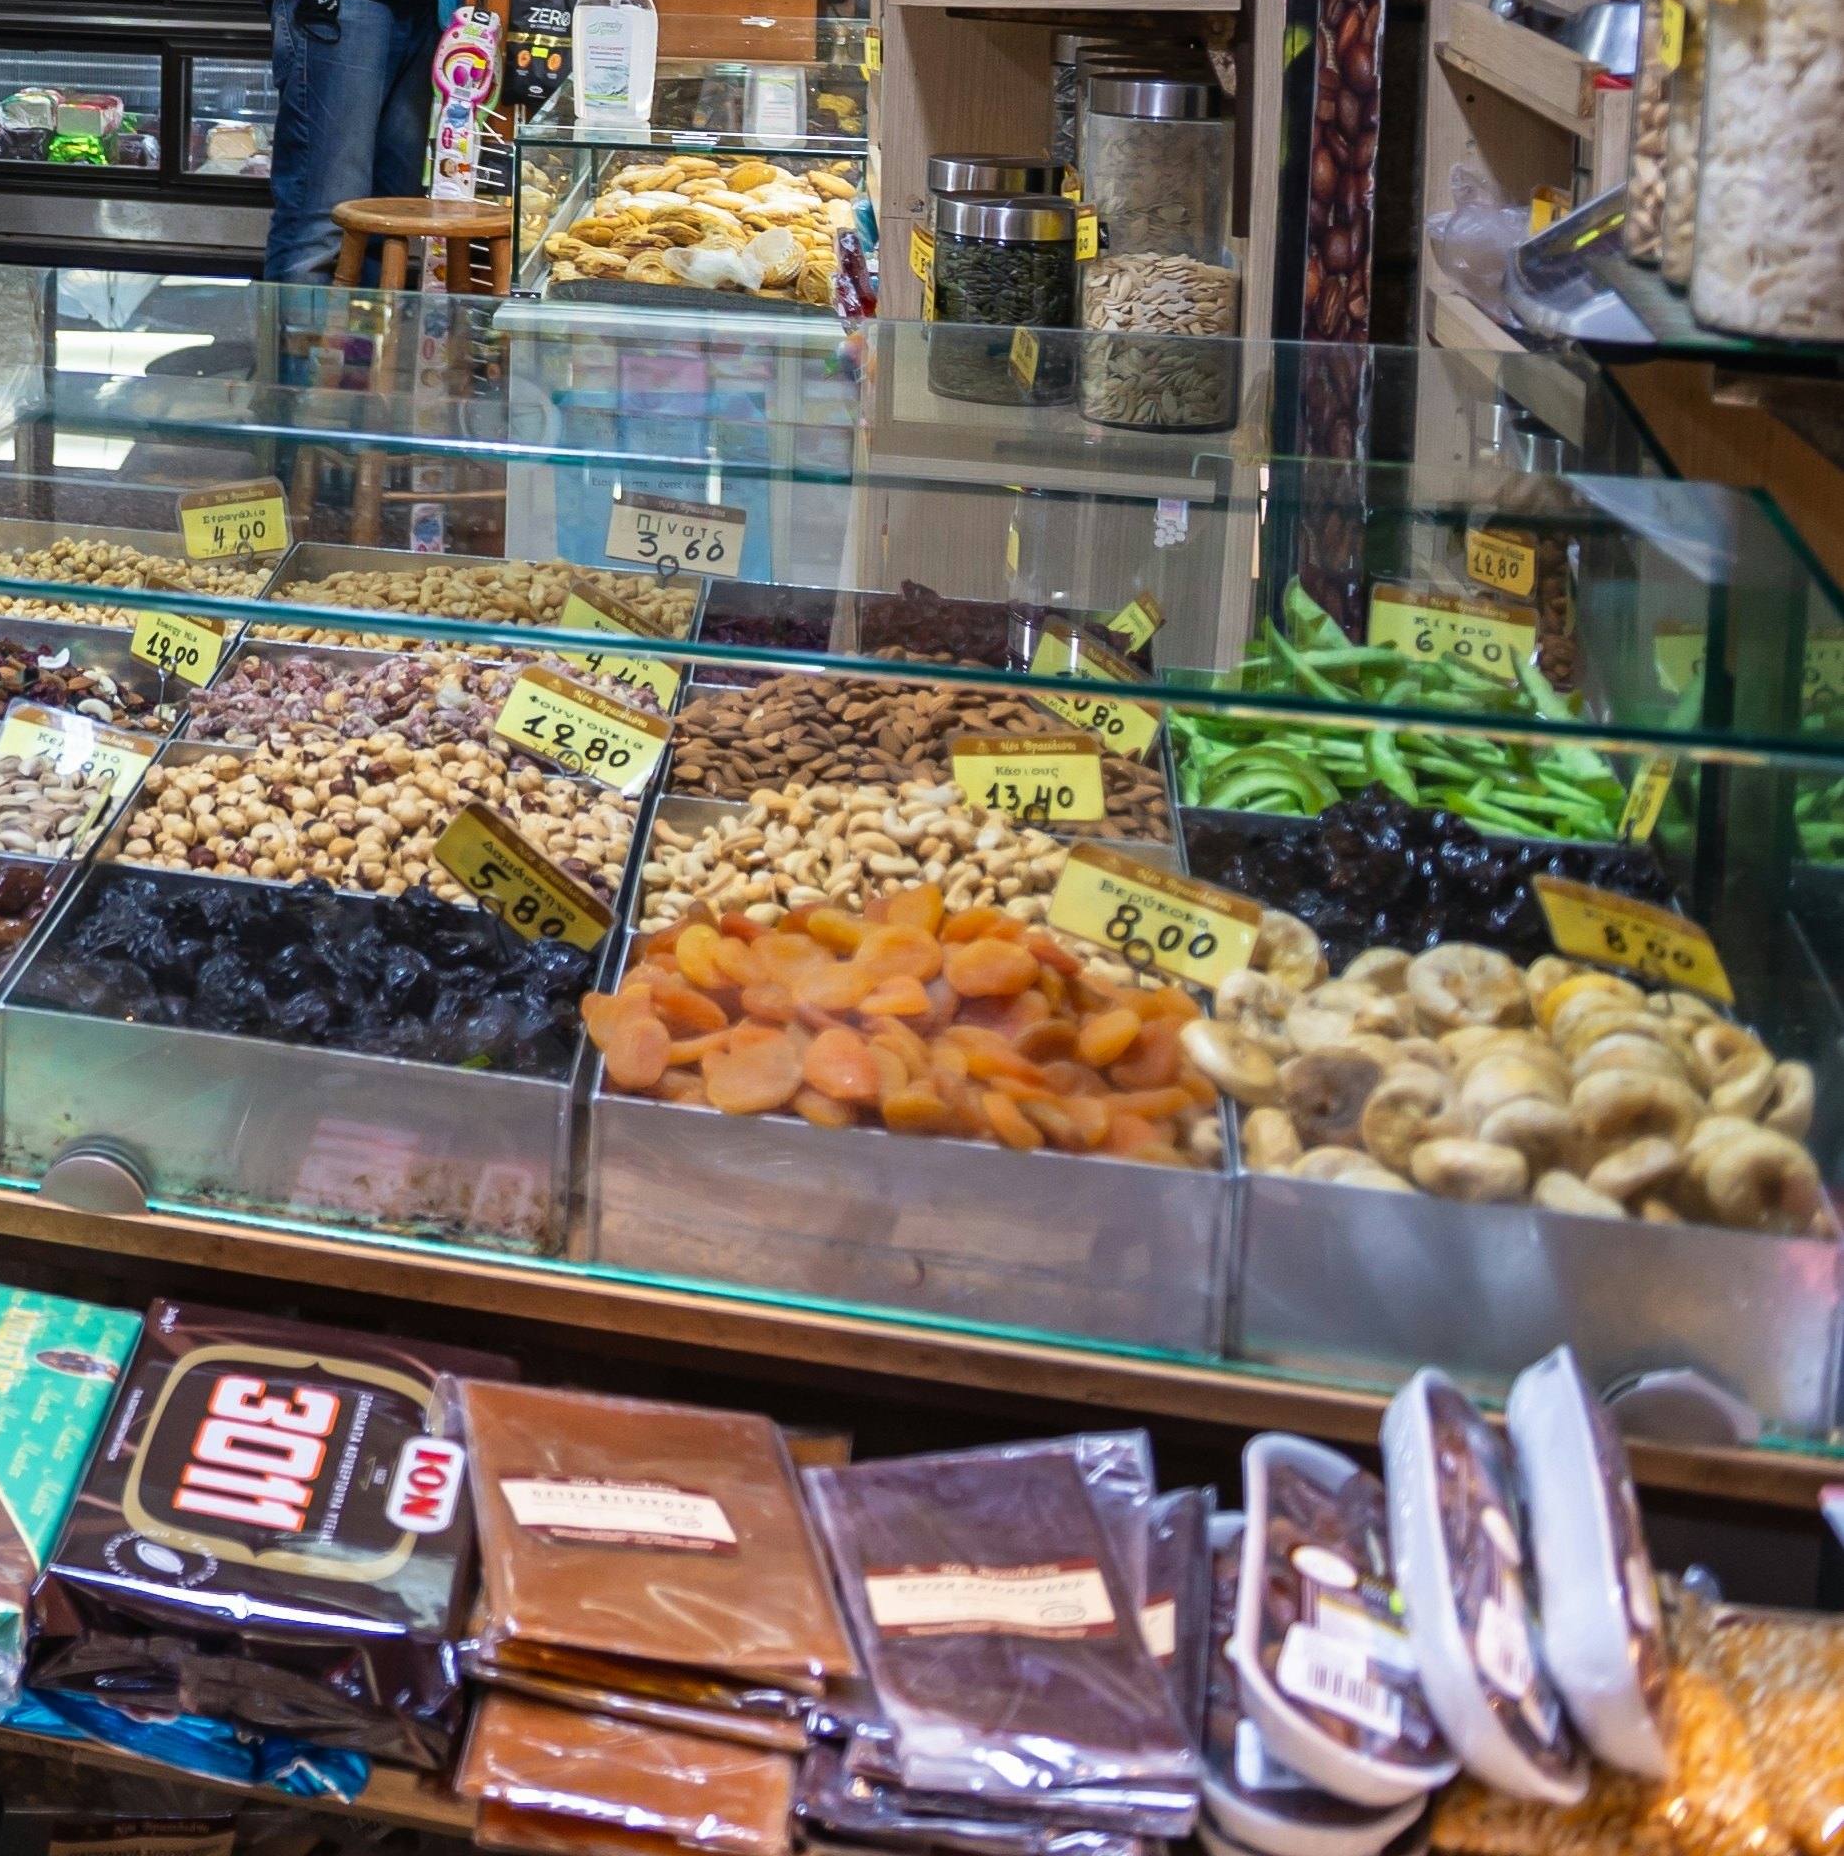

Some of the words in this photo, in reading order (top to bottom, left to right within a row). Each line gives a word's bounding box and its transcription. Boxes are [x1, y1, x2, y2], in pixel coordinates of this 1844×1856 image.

[528, 6, 572, 28] ZERO
[1106, 904, 1143, 943] 8
[171, 1374, 342, 1534] 3011
[397, 1443, 460, 1526] ION
